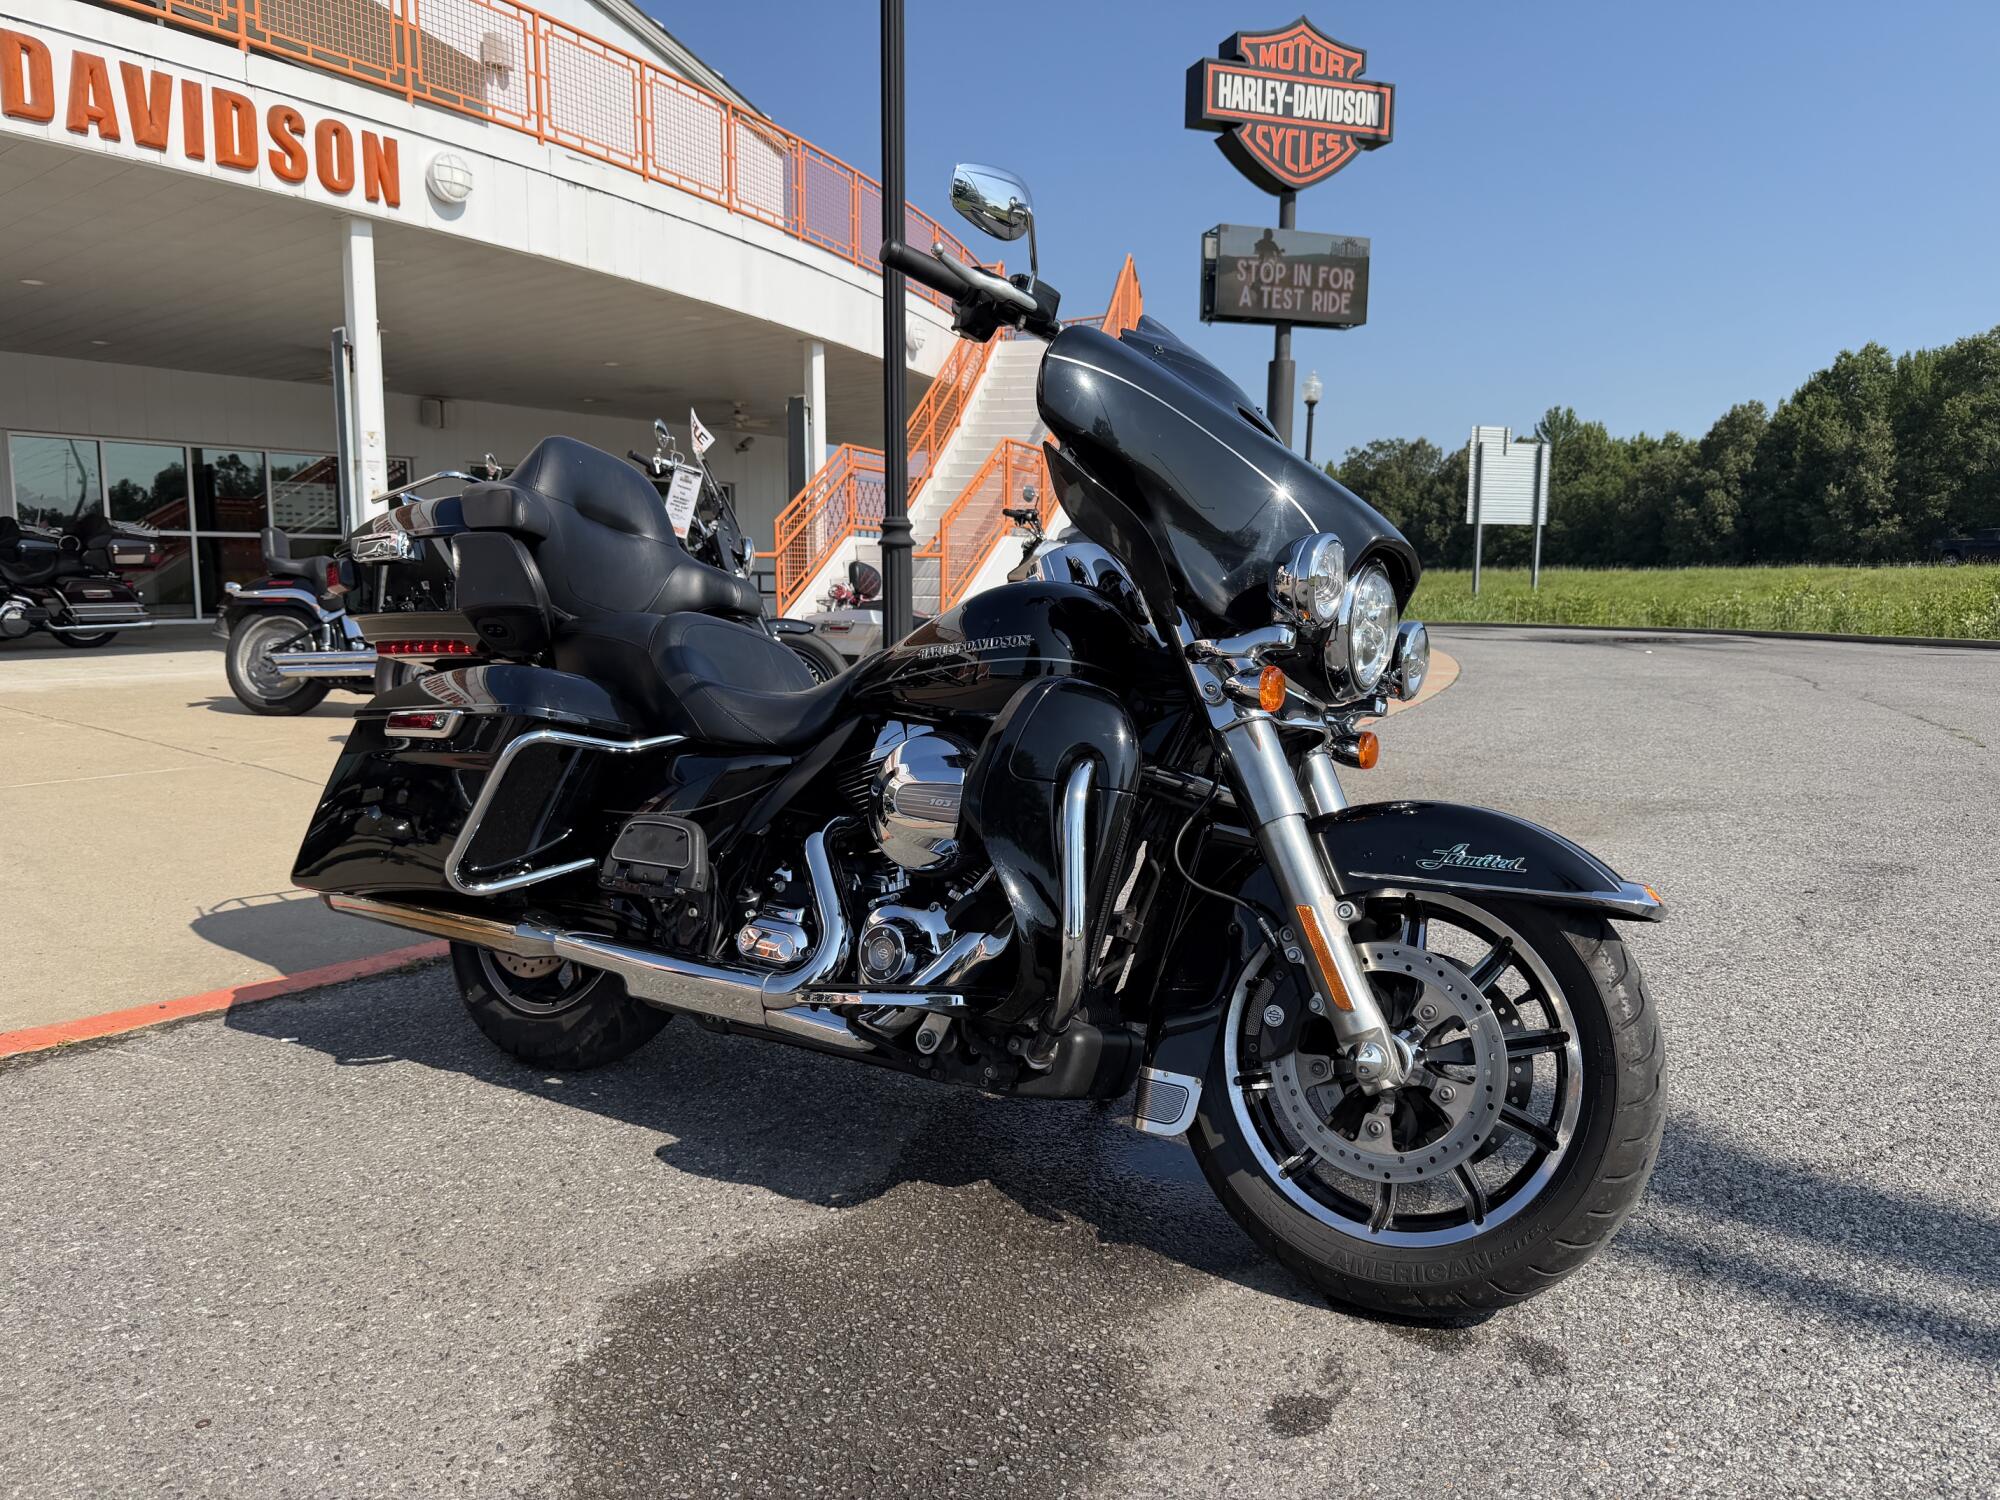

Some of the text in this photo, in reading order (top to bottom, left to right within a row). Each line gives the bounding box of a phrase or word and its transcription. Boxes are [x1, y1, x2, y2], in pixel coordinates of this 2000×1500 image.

[1259, 34, 1344, 78] MOTOR
[0, 28, 400, 208] DAVIDSON
[1218, 72, 1380, 128] HARLEY-DAVIDSON
[1255, 124, 1341, 173] CYCLES
[1237, 259, 1355, 291] STOP IN FOR
[1239, 285, 1351, 314] A TEST RIDE
[1415, 843, 1527, 873] Limited
